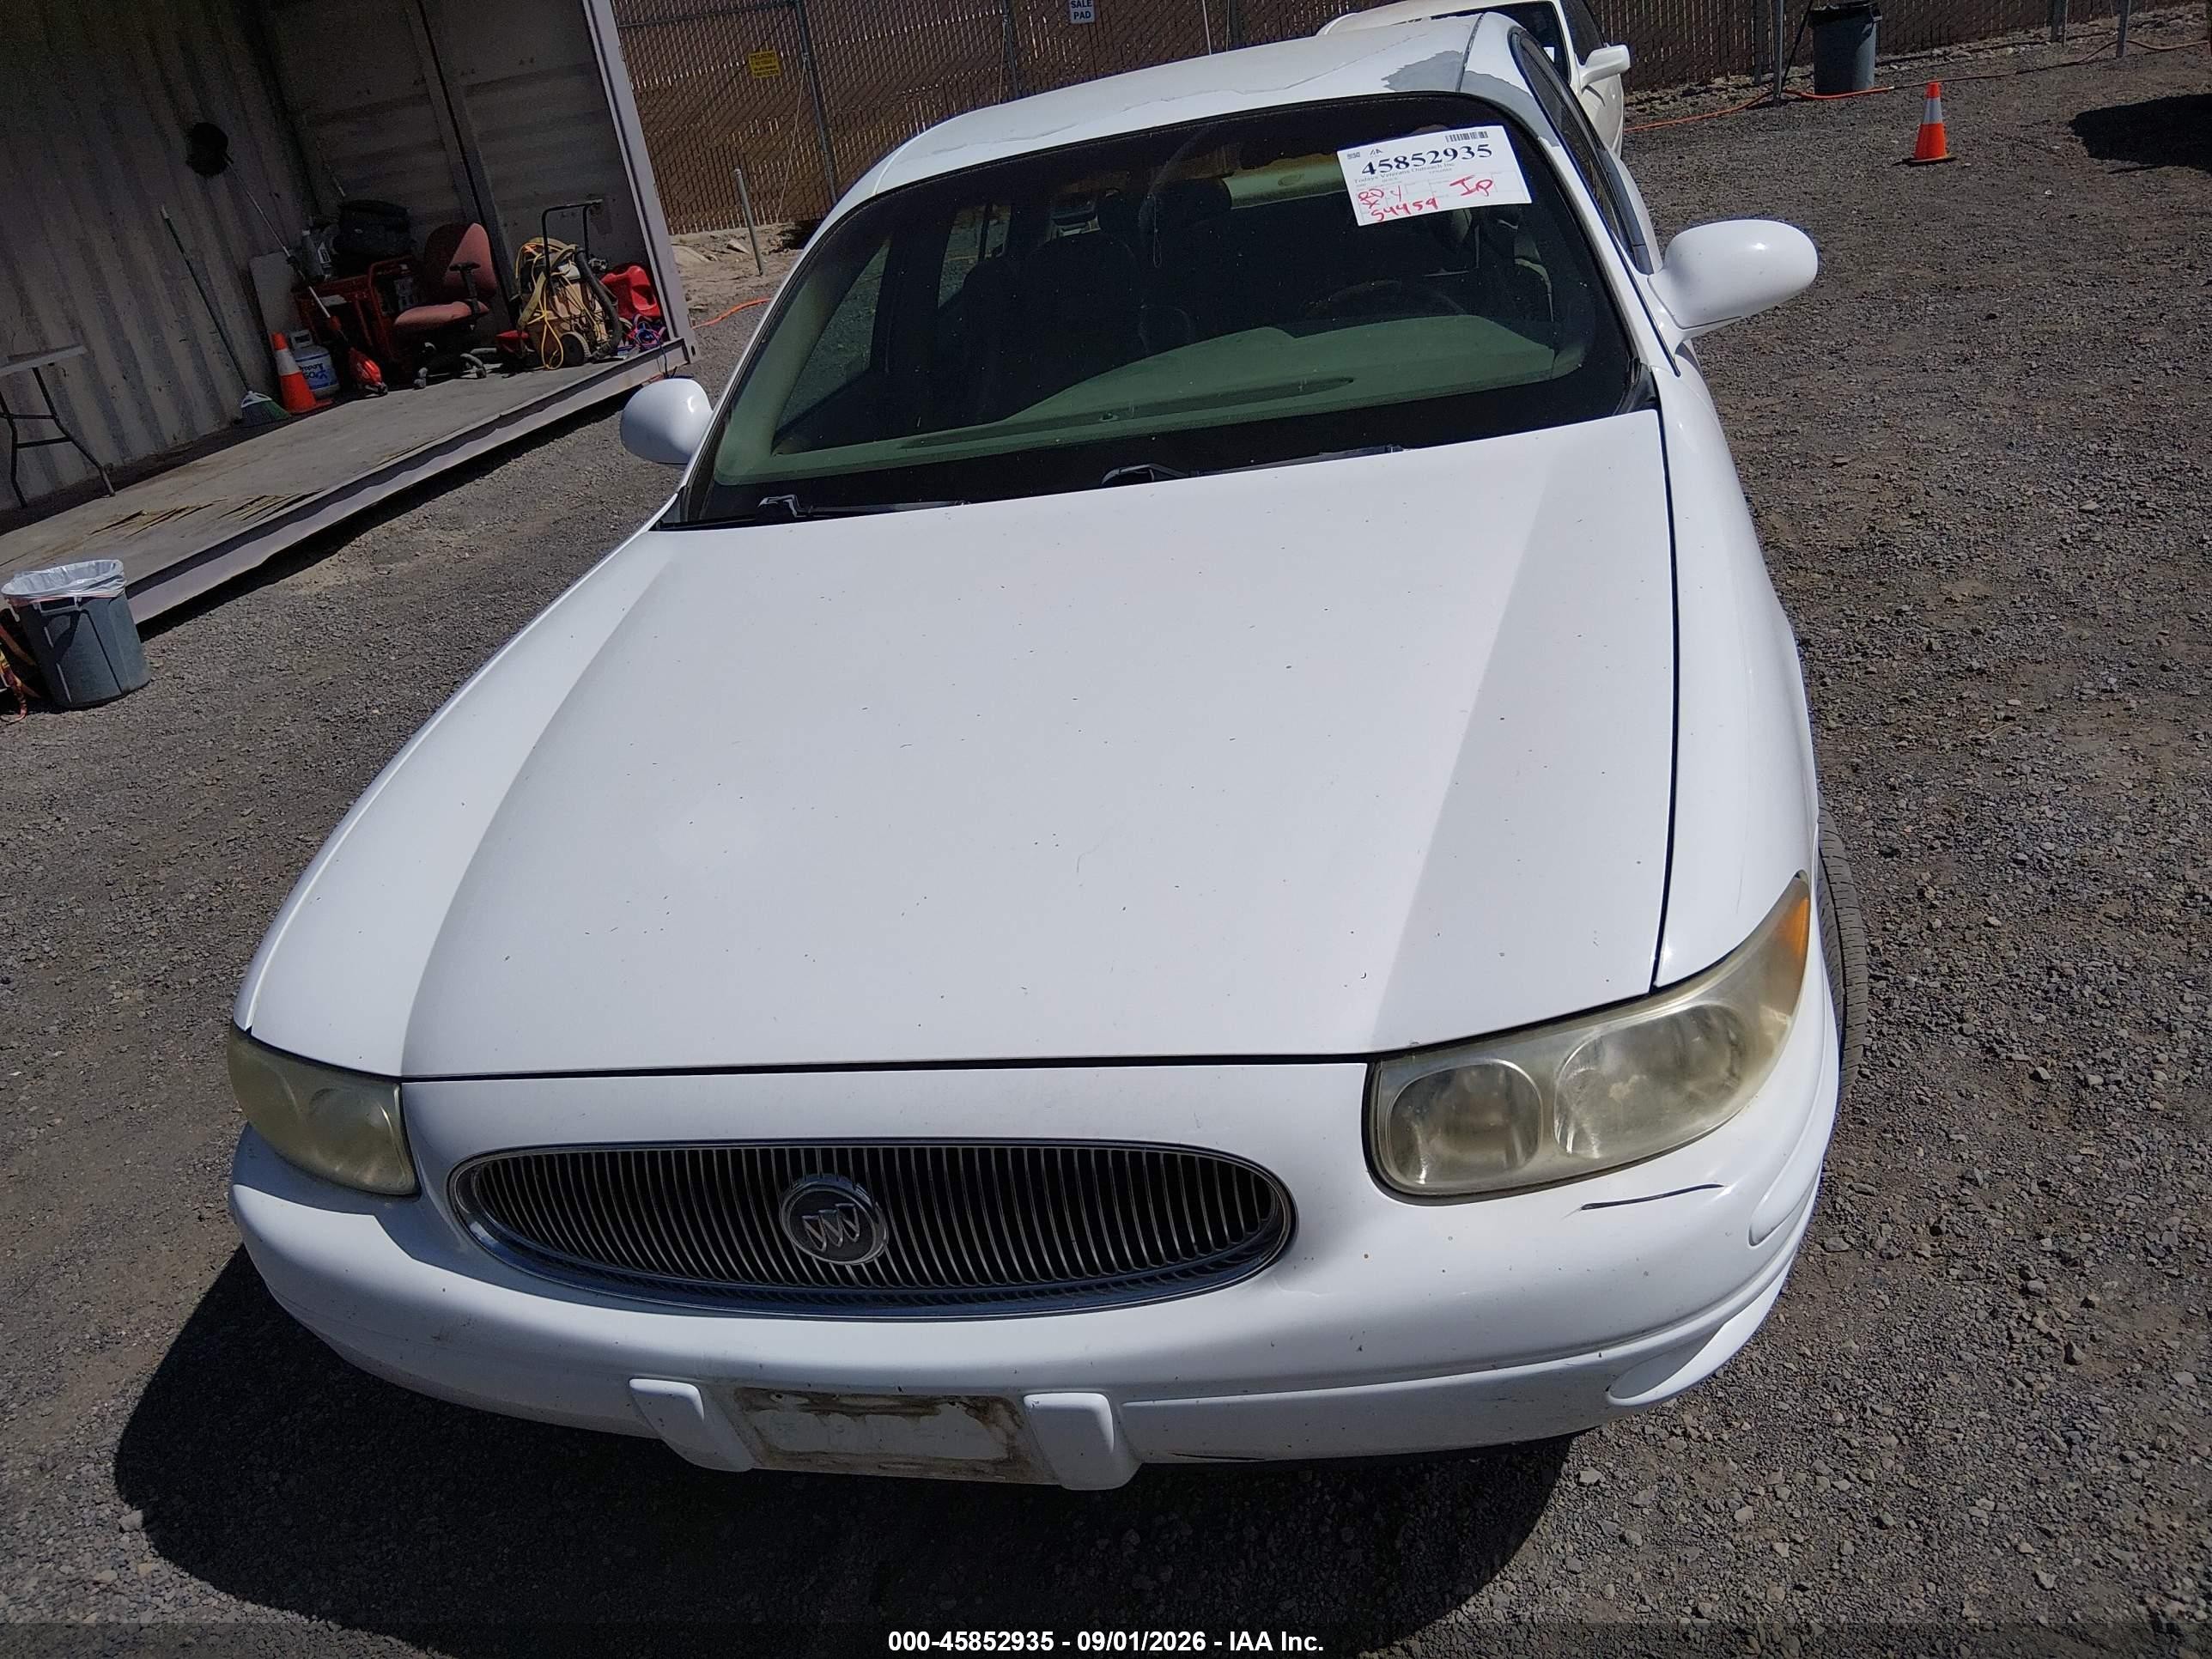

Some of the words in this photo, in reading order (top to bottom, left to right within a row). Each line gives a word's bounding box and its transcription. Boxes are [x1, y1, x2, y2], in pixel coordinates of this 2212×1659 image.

[1071, 0, 1092, 9] SALE
[1073, 10, 1091, 20] PAD
[1362, 144, 1492, 175] 45852935
